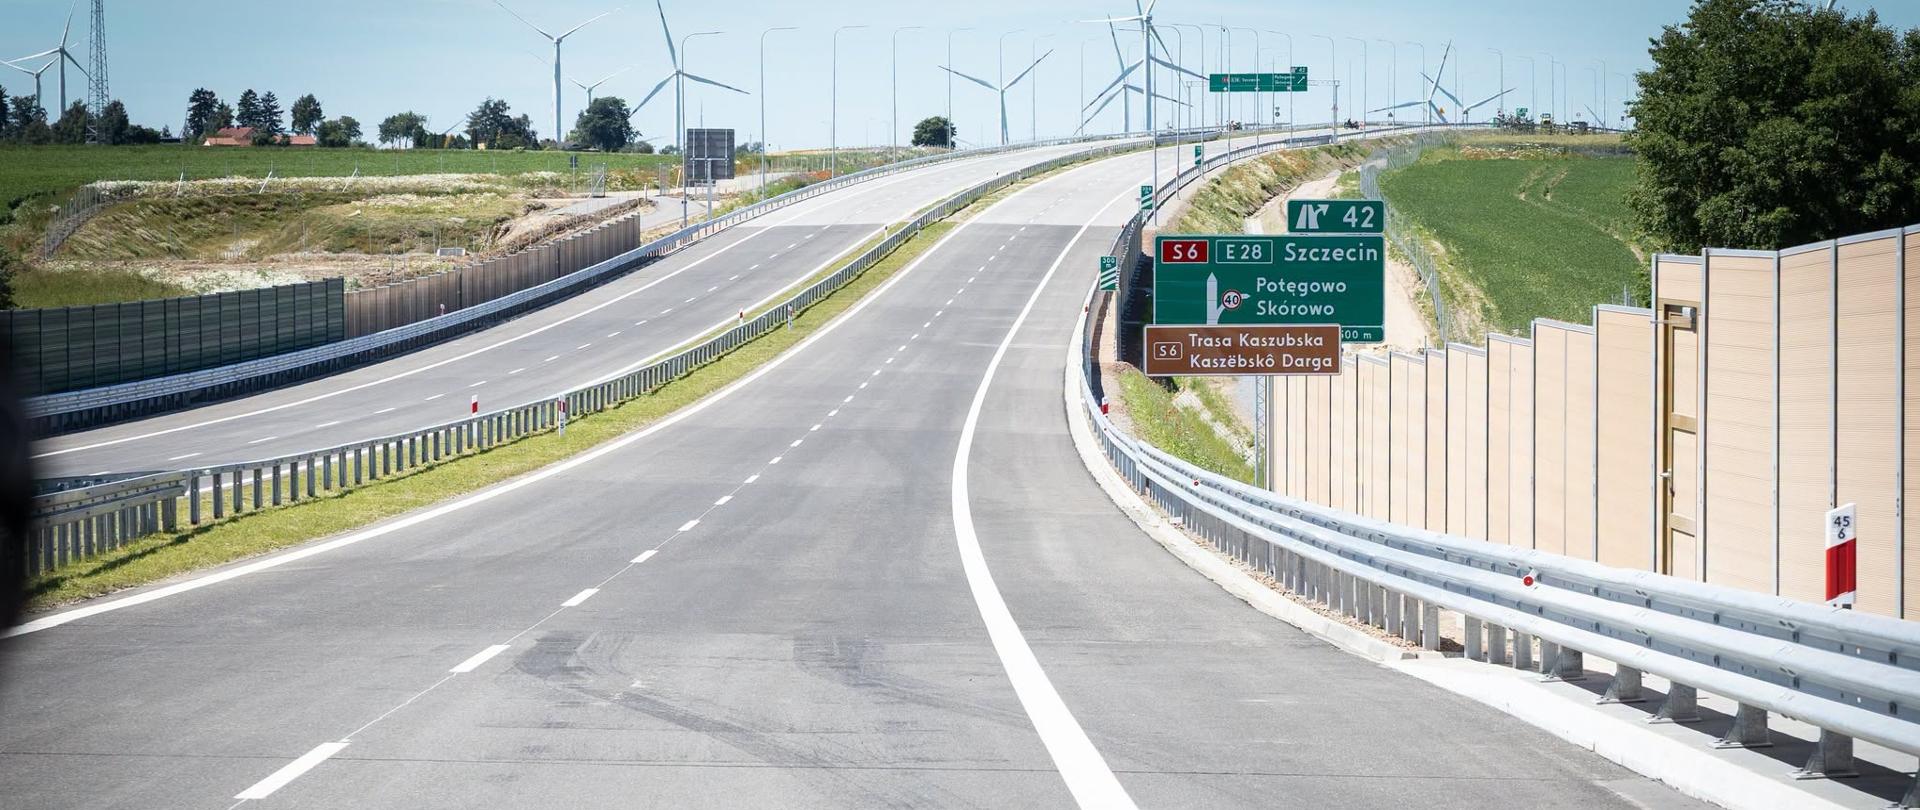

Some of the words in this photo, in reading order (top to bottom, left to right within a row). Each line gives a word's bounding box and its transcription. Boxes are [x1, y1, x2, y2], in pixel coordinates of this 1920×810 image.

[1343, 206, 1374, 228] 42
[1284, 242, 1378, 262] Szczecin
[1257, 277, 1347, 297] Potęgowo
[1224, 295, 1239, 305] 40
[1257, 299, 1335, 316] Skórowo
[1188, 333, 1232, 347] Trasa
[1239, 332, 1324, 347] Kaszubska
[1363, 332, 1372, 340] m
[1190, 353, 1275, 368] Kaszëbskô
[1282, 353, 1333, 372] Darga
[1834, 515, 1850, 527] 45
[1838, 527, 1846, 539] 6
